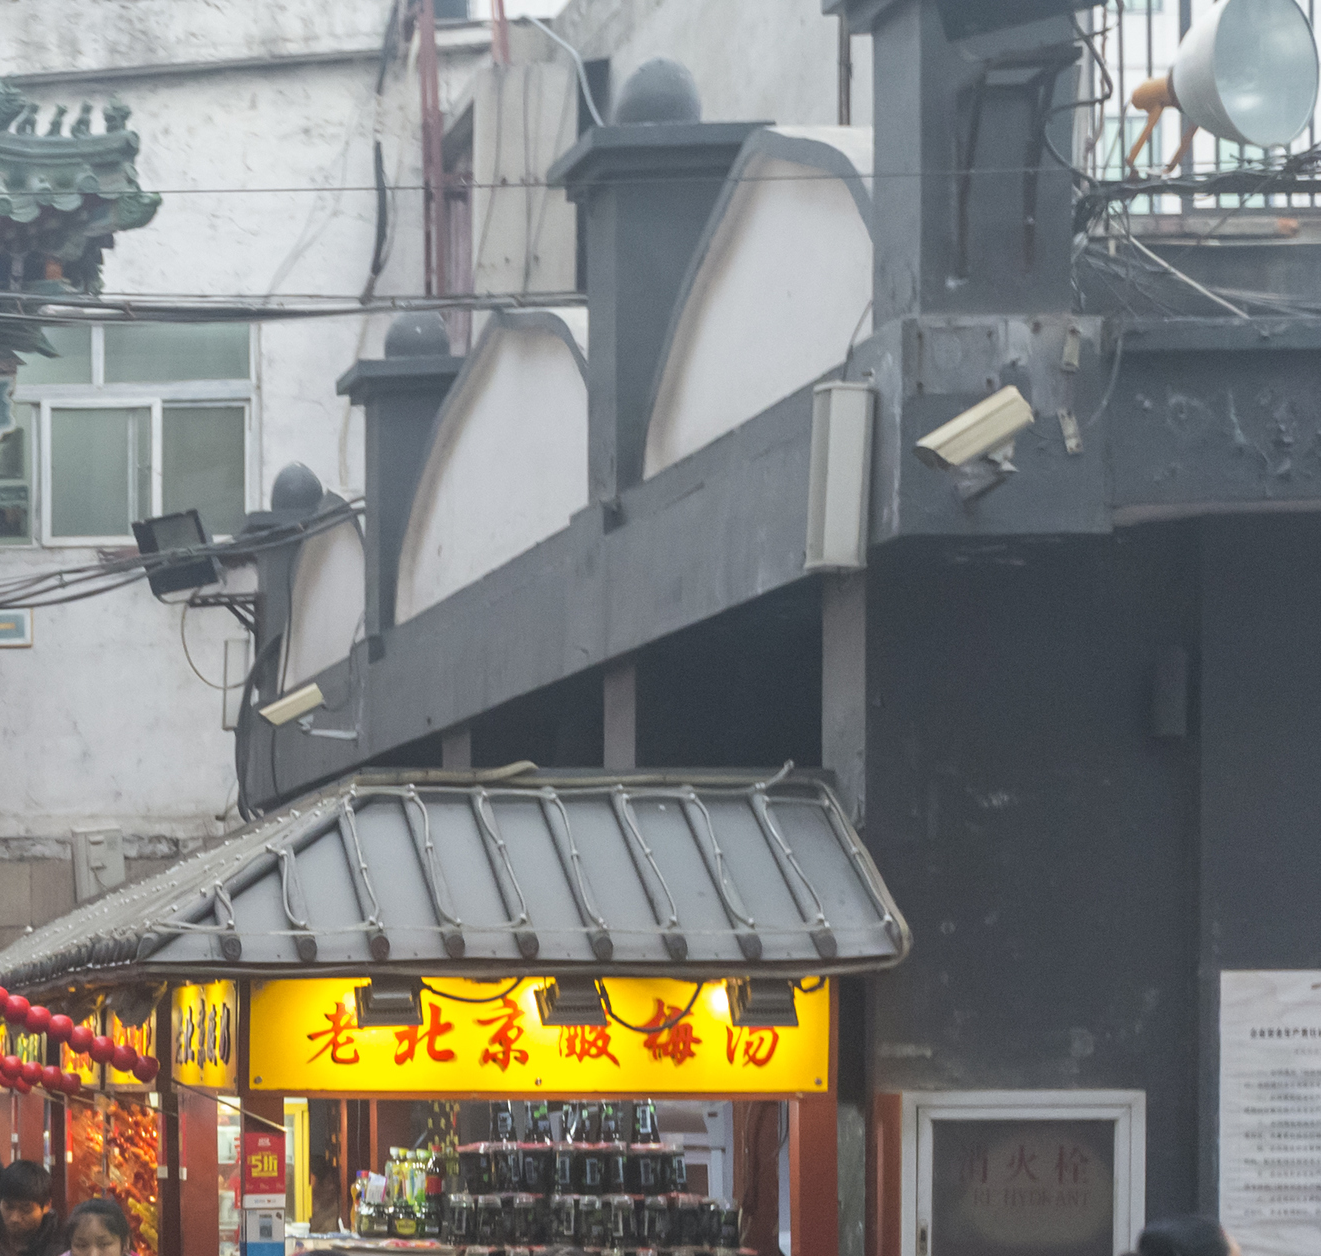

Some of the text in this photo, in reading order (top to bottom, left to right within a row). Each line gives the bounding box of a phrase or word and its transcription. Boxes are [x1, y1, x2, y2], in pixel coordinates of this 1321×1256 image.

[306, 998, 779, 1072] 老北京酸梅汤
